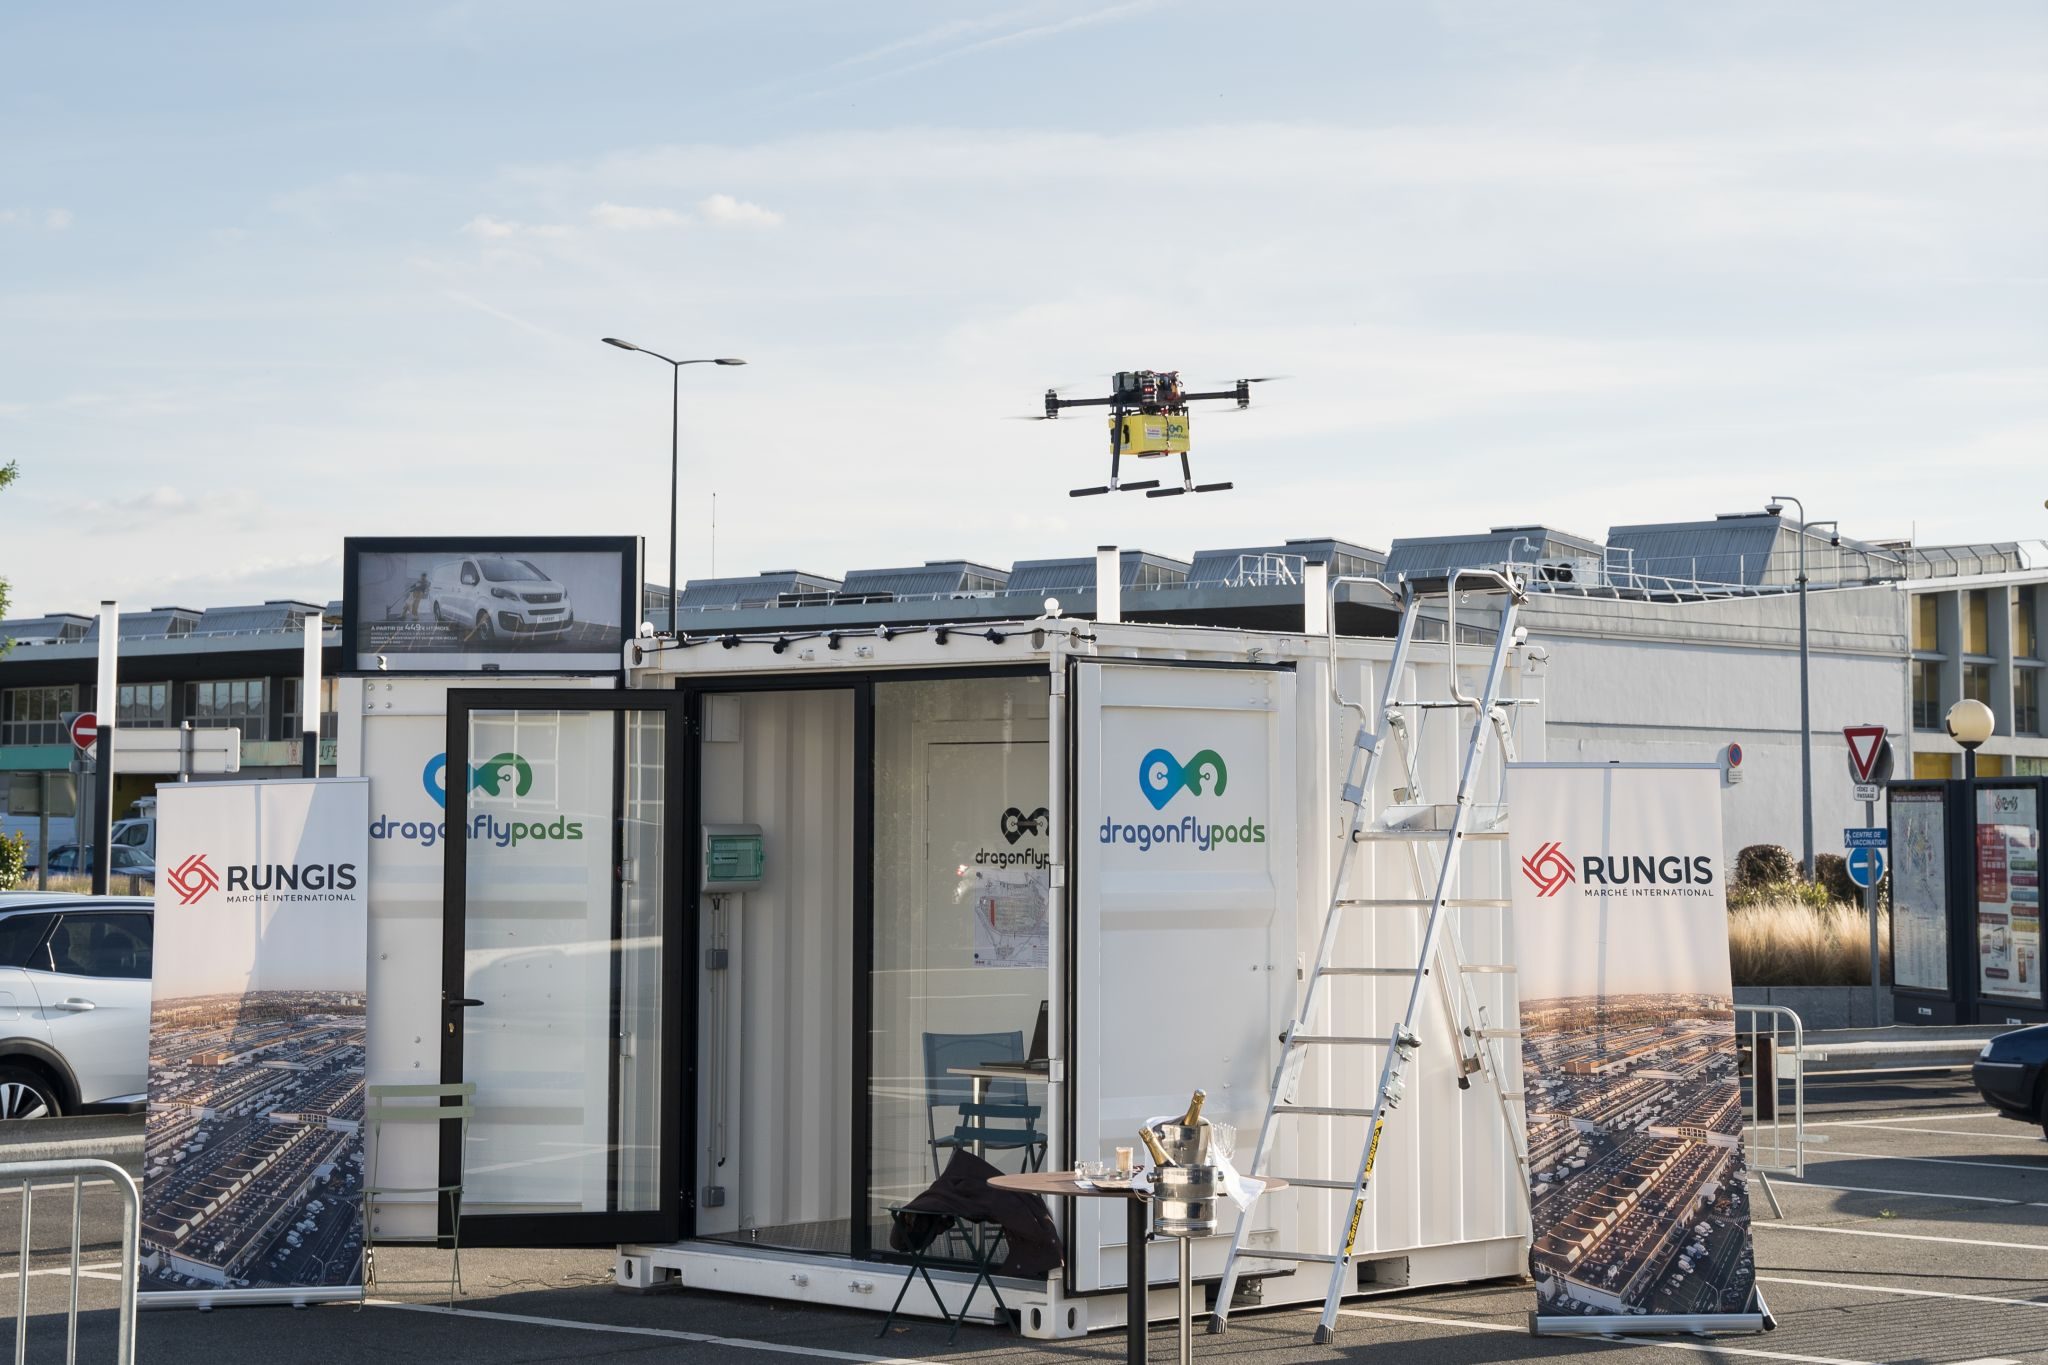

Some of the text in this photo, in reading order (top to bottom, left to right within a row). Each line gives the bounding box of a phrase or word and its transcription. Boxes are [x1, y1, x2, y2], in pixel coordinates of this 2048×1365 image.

[369, 814, 583, 847] dragflypads
[1100, 816, 1265, 851] dragonflypads
[975, 848, 1049, 870] dragonflyp
[1583, 855, 1713, 884] RUNGIS
[227, 863, 357, 891] RUNGIS
[226, 892, 356, 903] MARCHÉ INTERNATIONAL
[1585, 887, 1714, 897] MARCHÉ INTERNATIONAL
